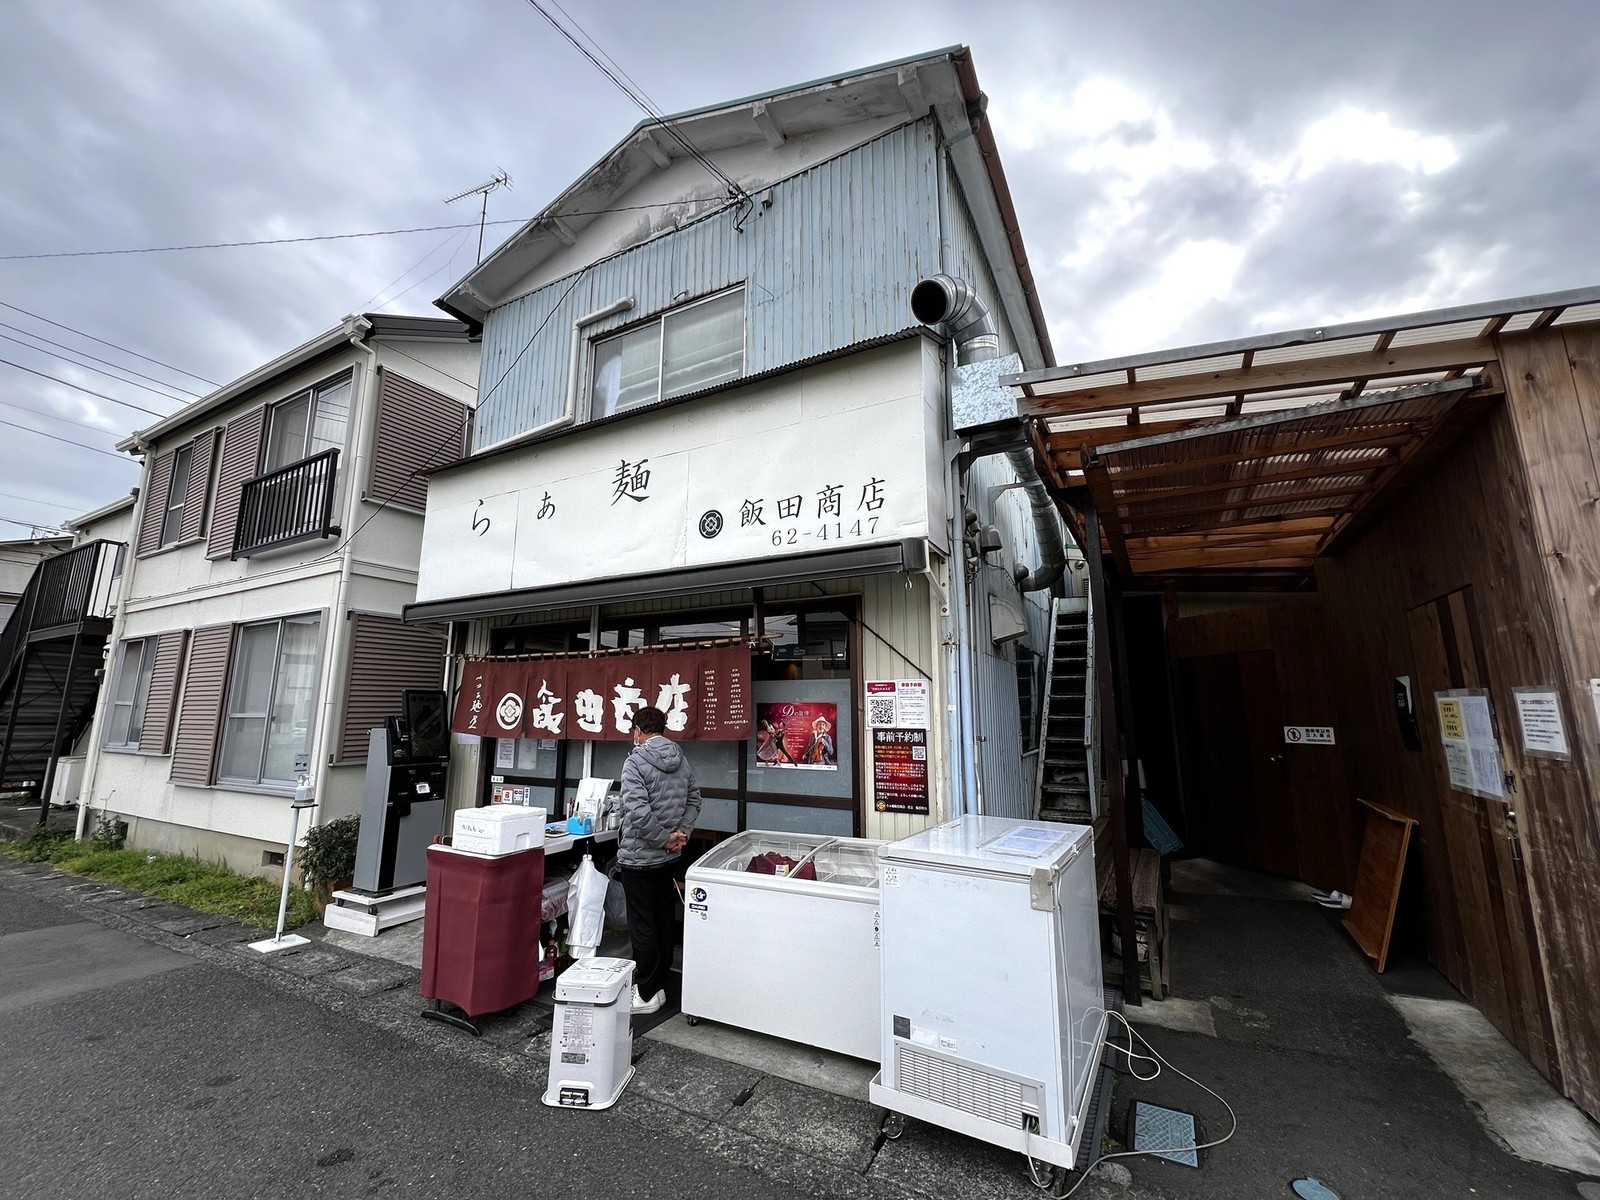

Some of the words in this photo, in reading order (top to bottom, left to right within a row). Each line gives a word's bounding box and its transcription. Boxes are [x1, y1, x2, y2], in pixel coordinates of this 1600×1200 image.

[738, 476, 886, 528] 飯田商店
[771, 516, 879, 547] 62-4147
[876, 731, 924, 743] 事前予約制
